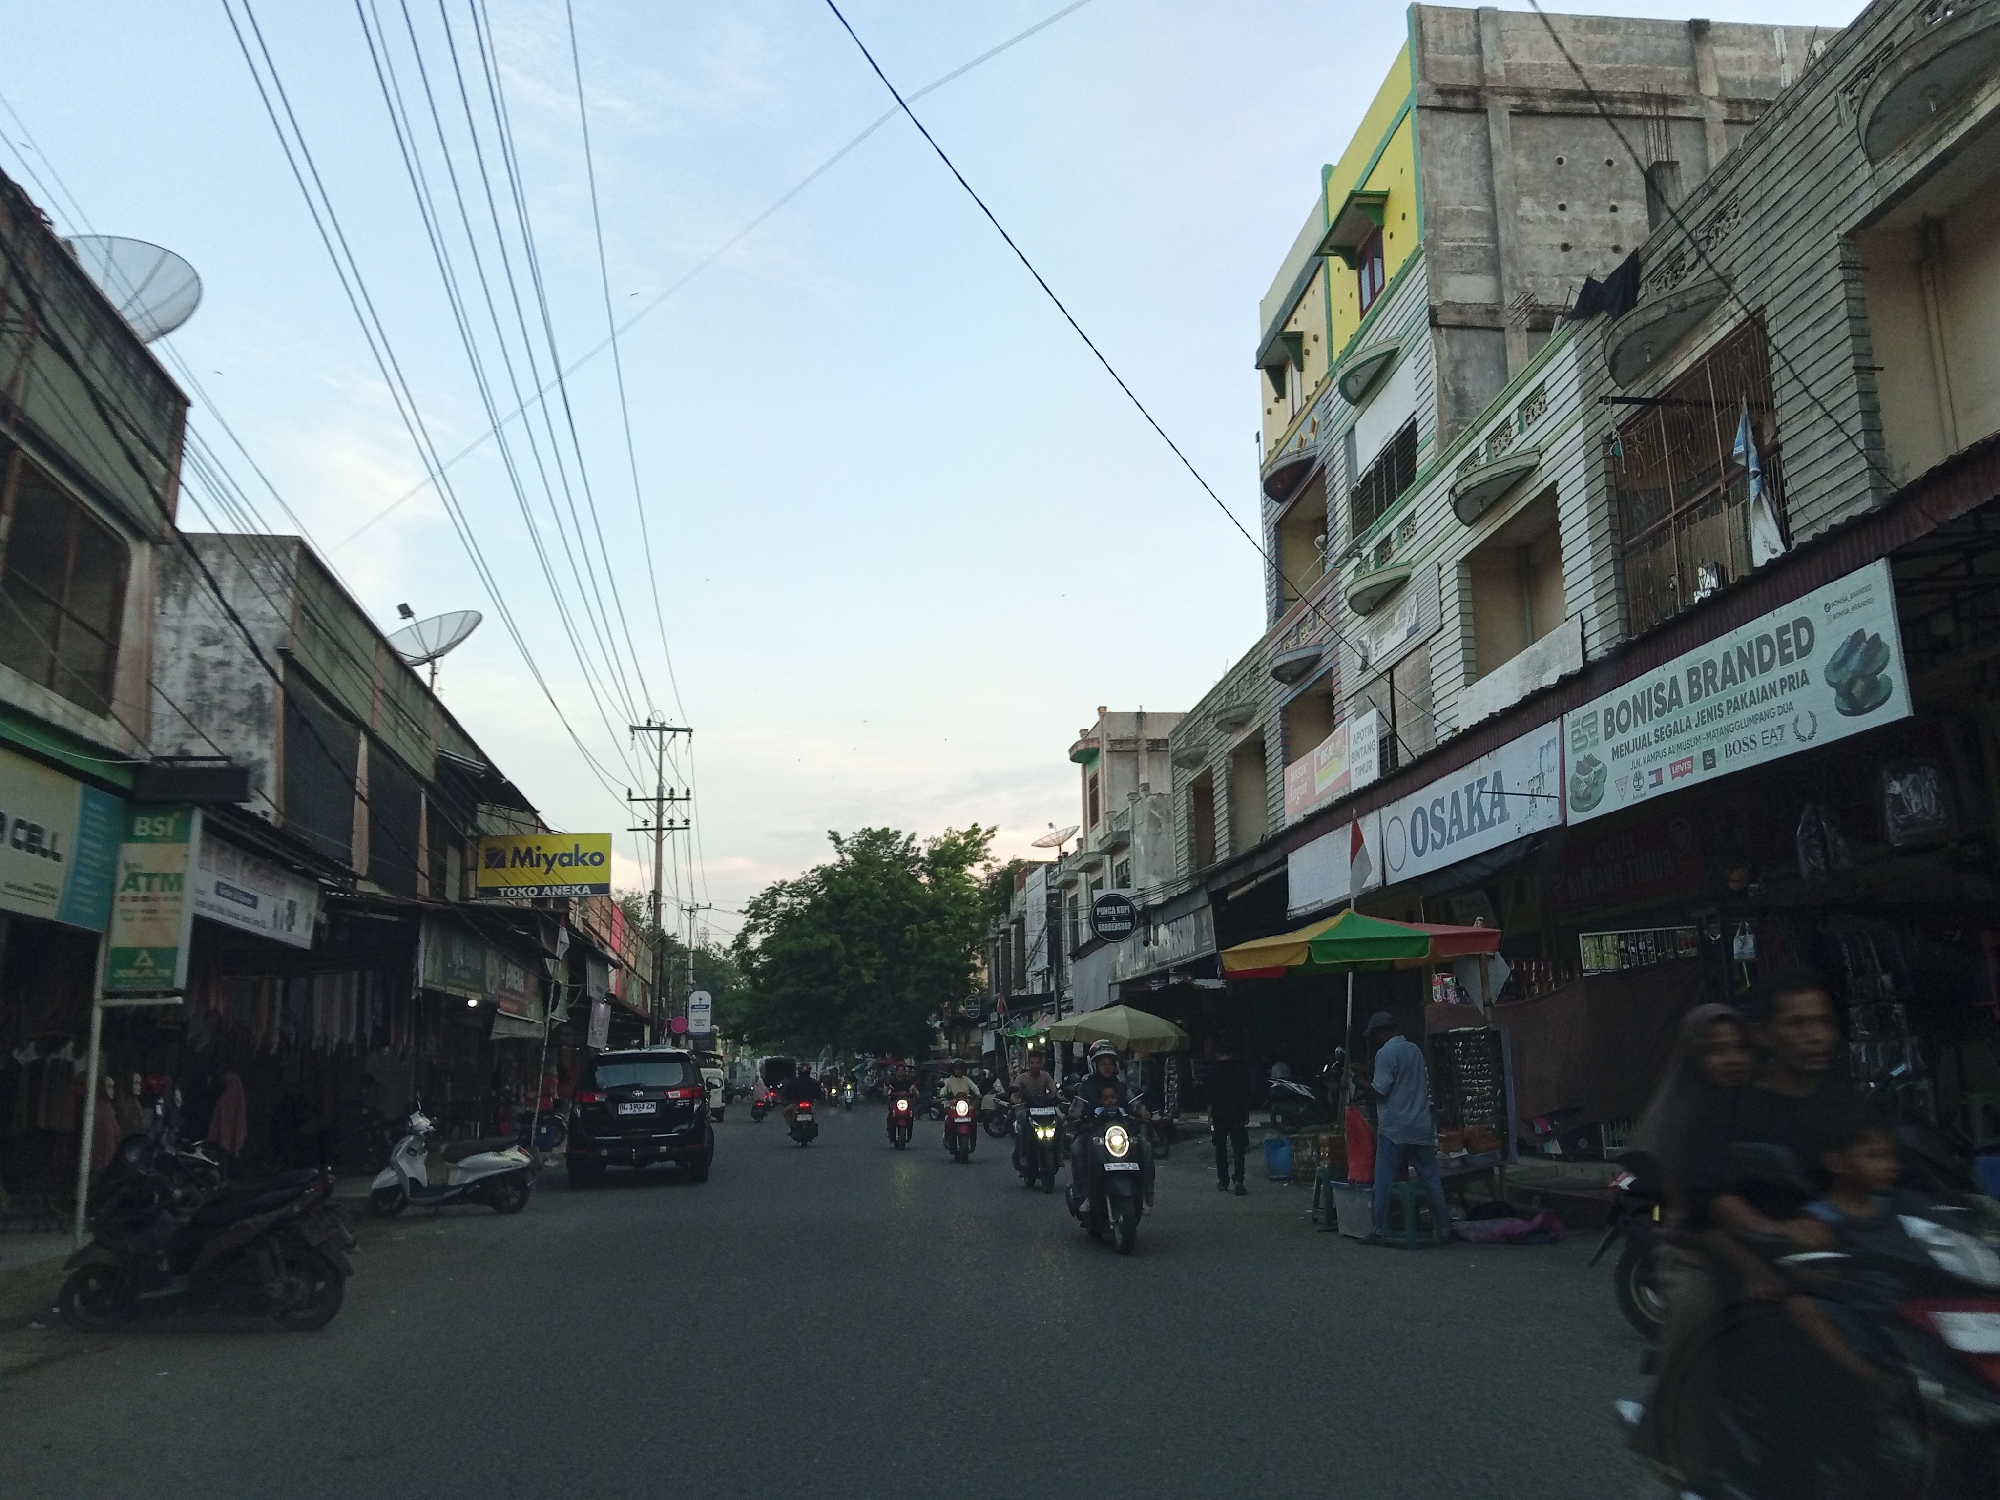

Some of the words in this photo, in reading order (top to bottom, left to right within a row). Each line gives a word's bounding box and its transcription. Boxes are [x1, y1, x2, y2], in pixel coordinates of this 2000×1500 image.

[1603, 679, 1683, 742] BONISA
[1687, 615, 1816, 701] BRANDED
[1611, 733, 1653, 762] MENJUAL
[1653, 720, 1692, 744] SEGALA
[1694, 705, 1726, 734] JENIS
[1726, 685, 1779, 721] PAKAIAN
[1780, 668, 1811, 697] PRIA
[1352, 722, 1375, 746] APOTIK
[1643, 747, 1668, 765] KAMPUS
[1677, 737, 1702, 754] MUSLIM
[1777, 702, 1795, 716] DUA
[1724, 734, 1758, 759] BOSS
[1761, 724, 1786, 747] EA7
[1351, 739, 1376, 765] BINTANG
[1354, 759, 1374, 779] TIMUR
[134, 815, 174, 837] BSI
[1410, 769, 1511, 859] OSAKA
[11, 817, 63, 863] CELL
[510, 843, 605, 875] Miyako
[121, 873, 183, 893] ATM
[498, 886, 539, 898] TOKO
[541, 885, 592, 897] ANEKA
